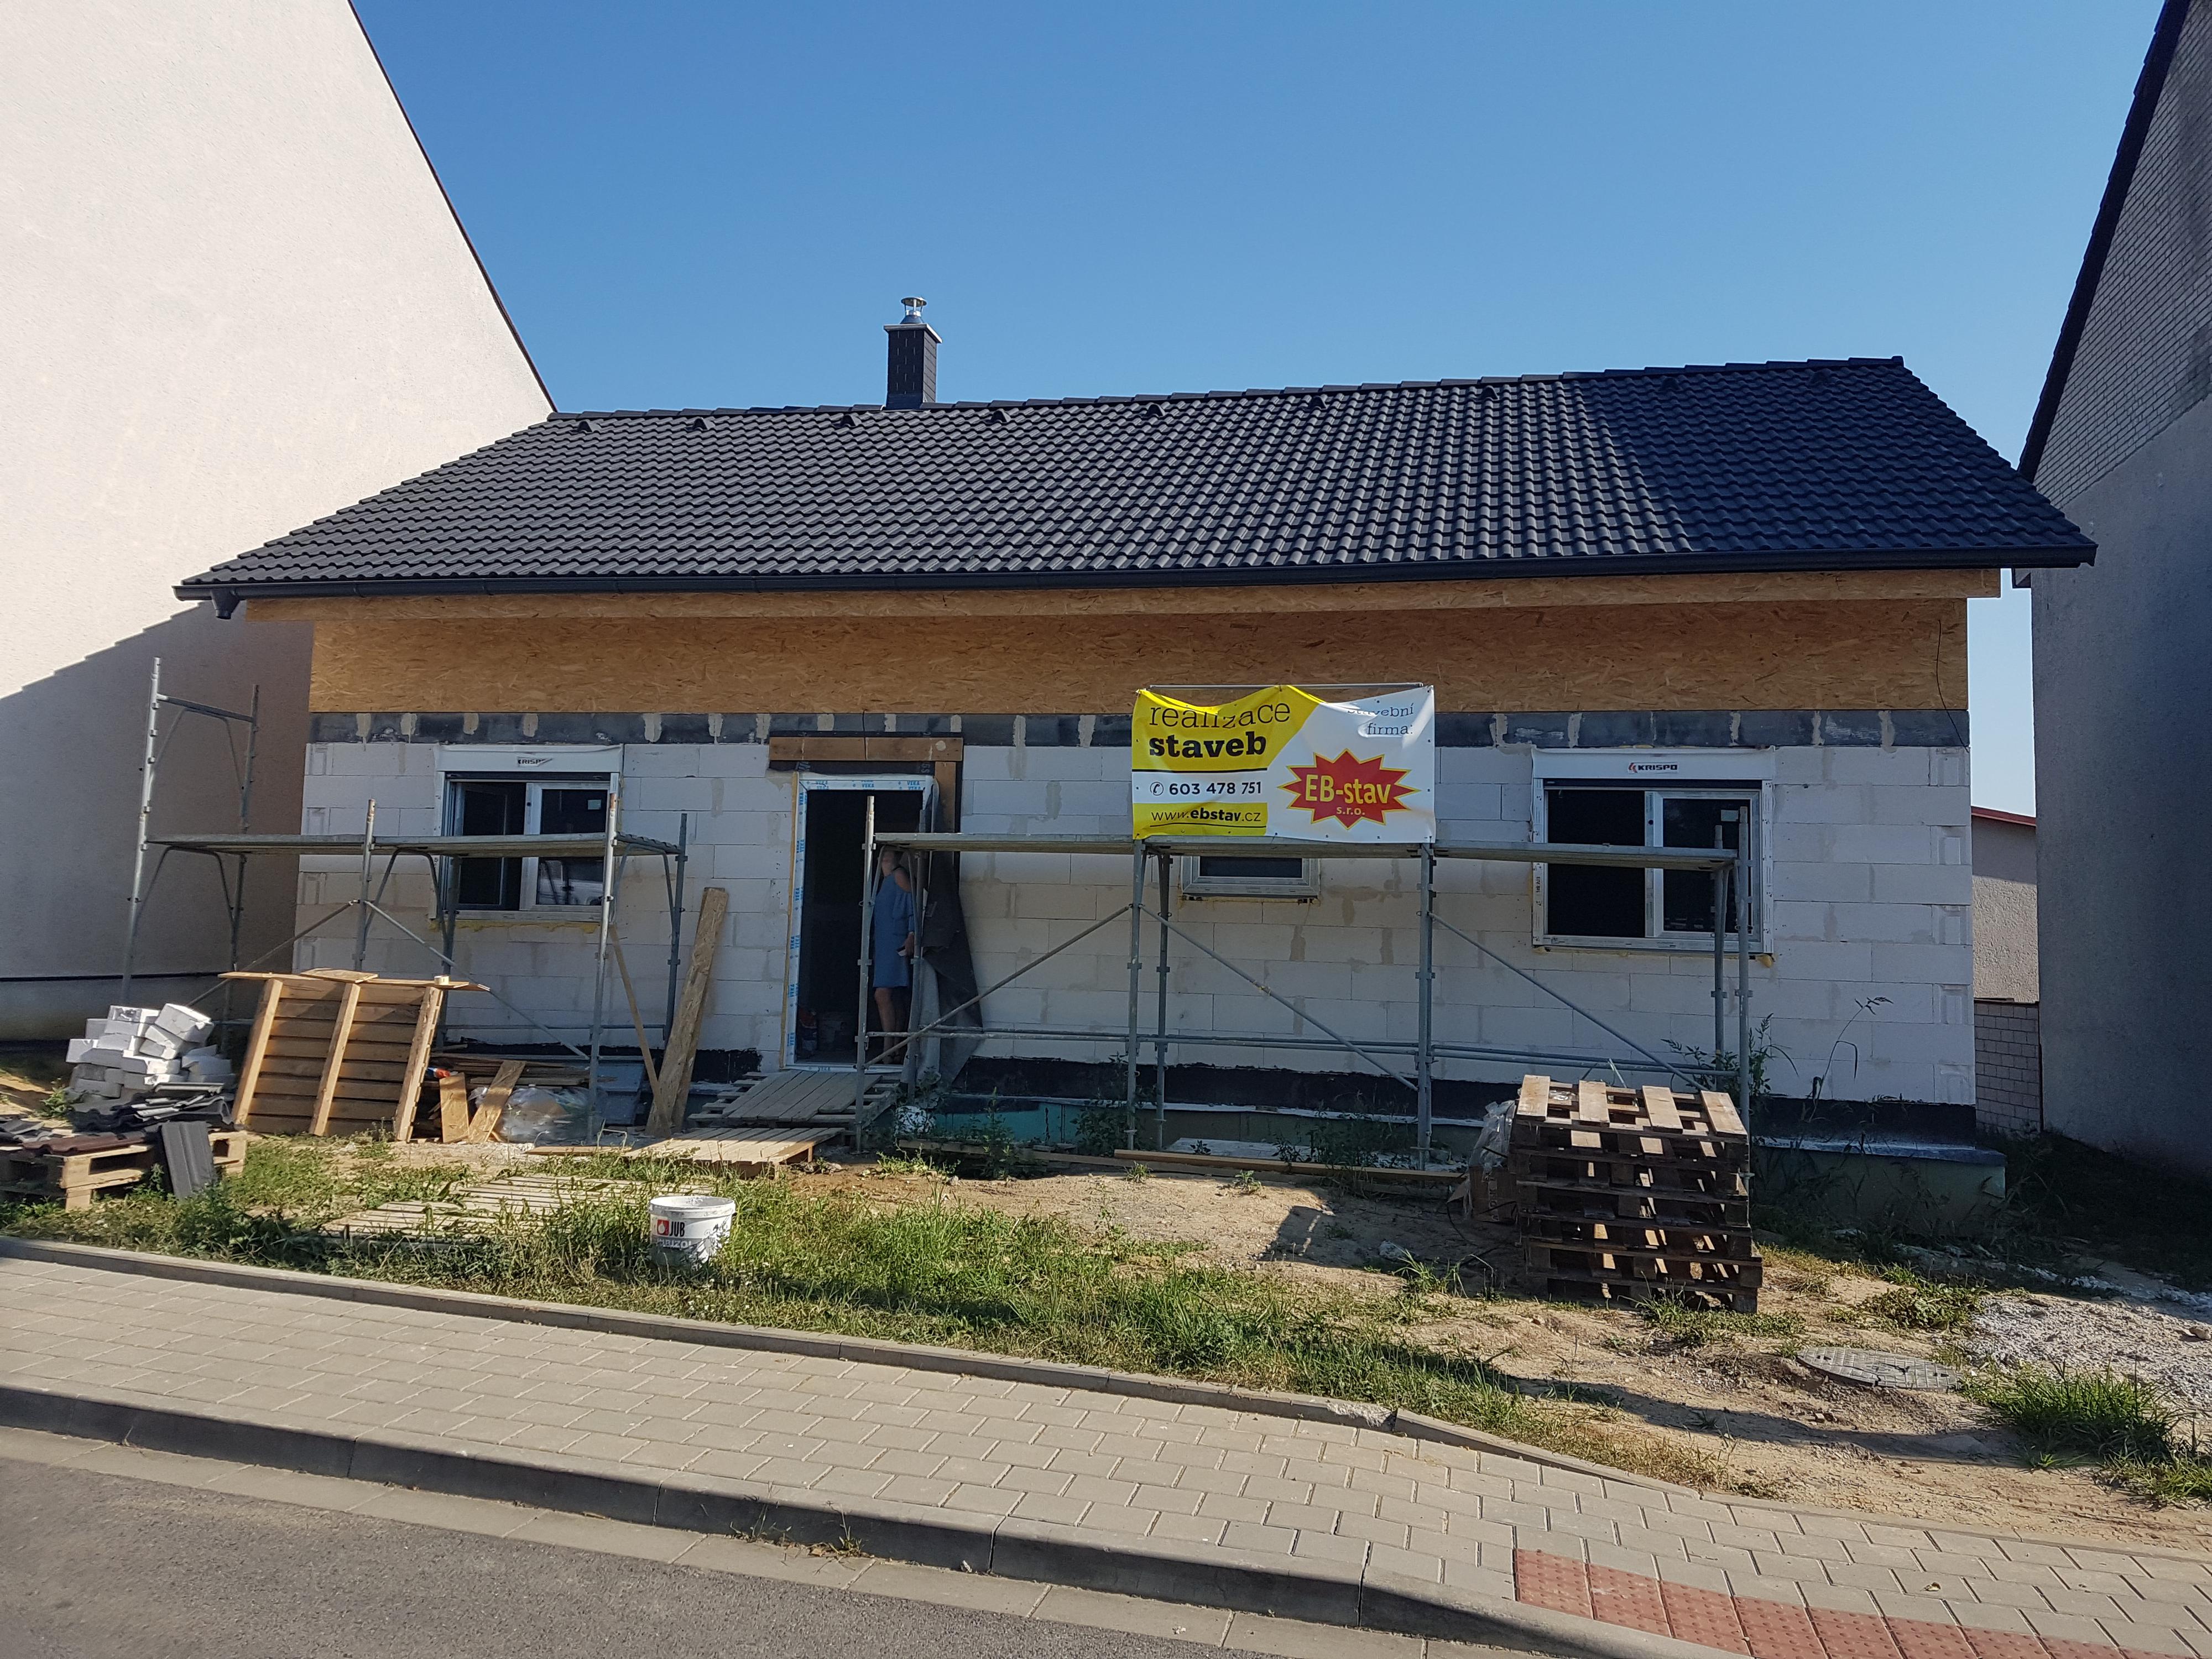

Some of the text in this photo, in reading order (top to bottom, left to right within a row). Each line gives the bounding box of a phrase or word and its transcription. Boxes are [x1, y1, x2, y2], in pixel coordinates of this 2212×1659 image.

[1367, 723, 1413, 735] firma:
[1149, 731, 1266, 758] staveb
[1169, 781, 1261, 795] 603 478 751
[1305, 774, 1391, 804] EB-stav
[1151, 807, 1261, 822] www.ebstav.cz
[1336, 807, 1365, 815] s.r.o.
[670, 1221, 685, 1237] JUB
